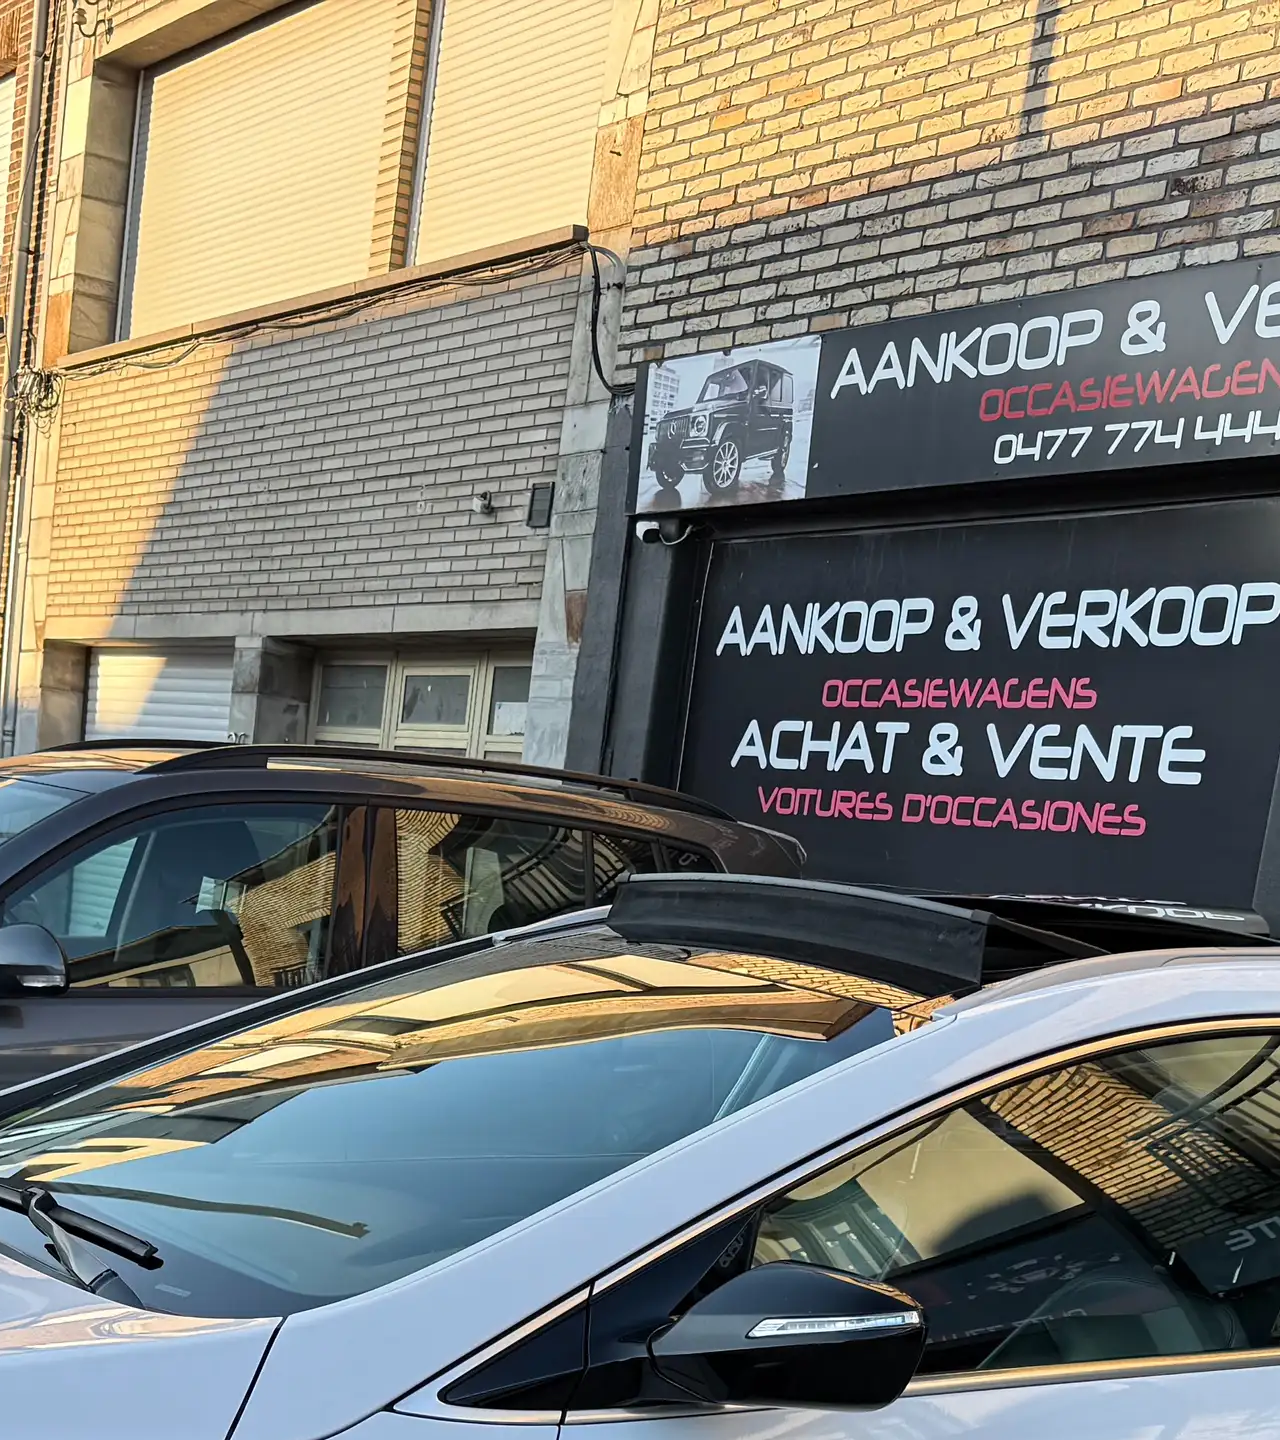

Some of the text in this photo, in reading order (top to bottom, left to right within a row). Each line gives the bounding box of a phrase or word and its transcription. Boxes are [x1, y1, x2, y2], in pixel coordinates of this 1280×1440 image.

[829, 308, 1103, 400] AANKOOP
[1120, 299, 1167, 356] &
[993, 426, 1093, 465] 0477
[1105, 417, 1184, 456] 774
[715, 596, 936, 657] AANKOOP
[944, 596, 982, 651] &
[822, 677, 1098, 711] OCCASIEWAGENS
[730, 719, 1206, 786] ACHAT & VENTE
[758, 787, 1147, 836] VOITURES D'OCCASIONES
